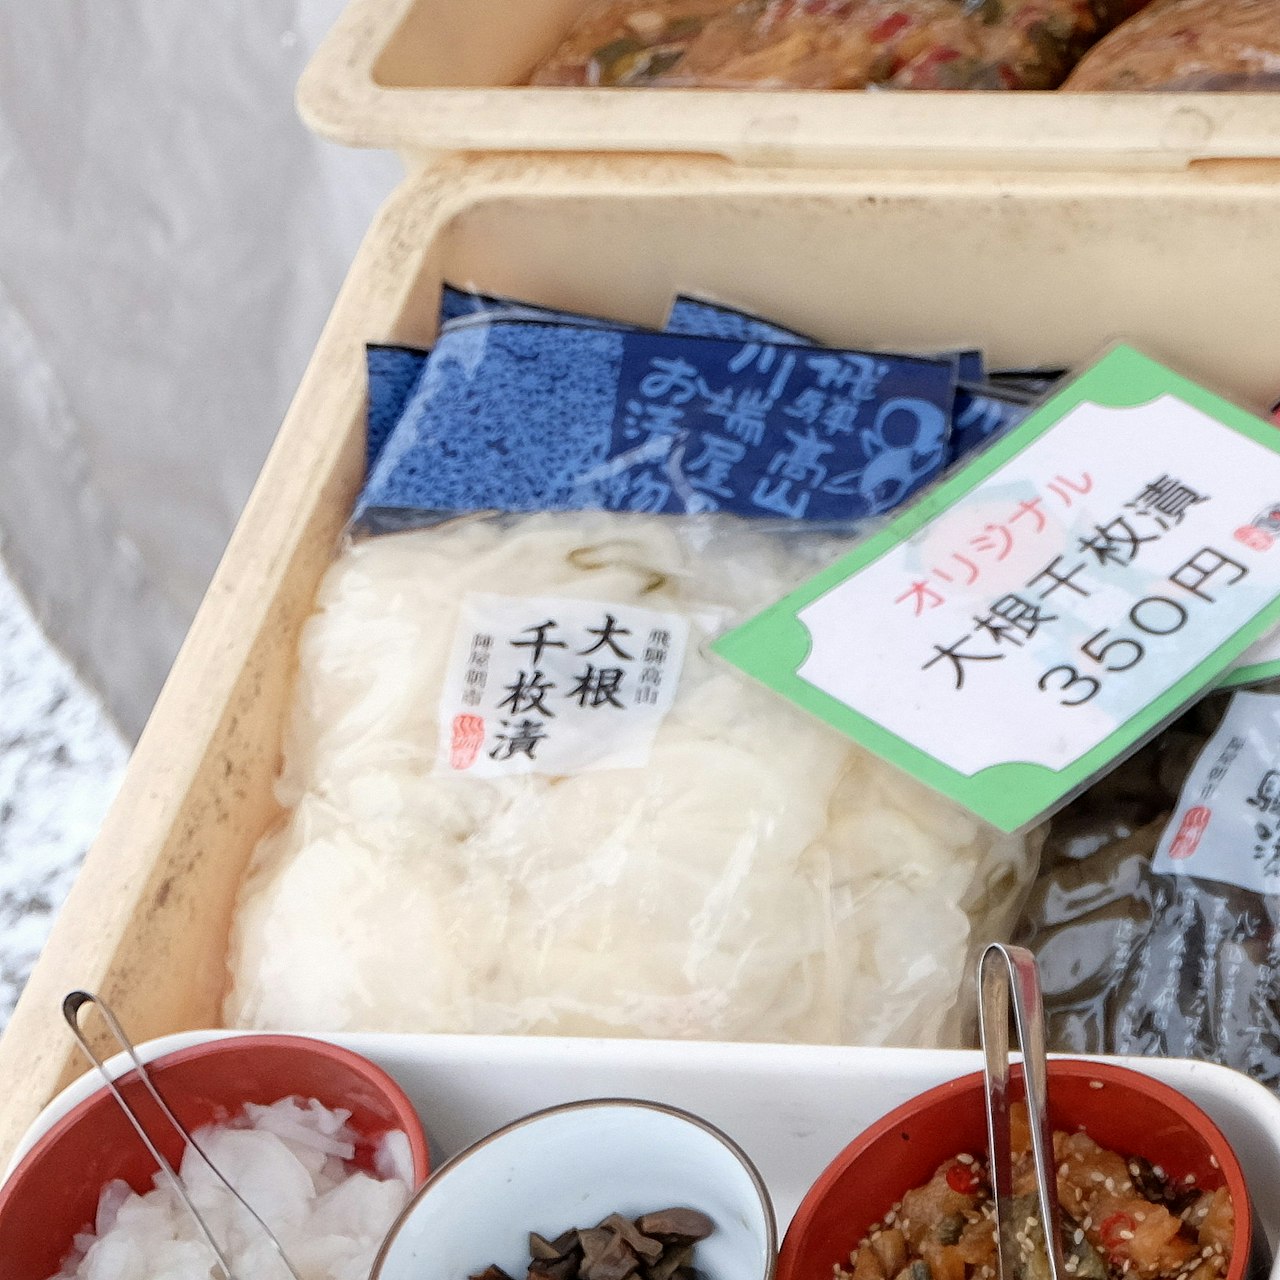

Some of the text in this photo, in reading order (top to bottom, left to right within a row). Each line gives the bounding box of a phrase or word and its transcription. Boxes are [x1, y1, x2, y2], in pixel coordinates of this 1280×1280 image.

[896, 471, 1093, 616] オリジナル
[921, 474, 1210, 690] 大根千枚漬
[488, 619, 567, 761] 千枚漬
[565, 614, 635, 709] 大根
[1038, 545, 1249, 706] 350円
